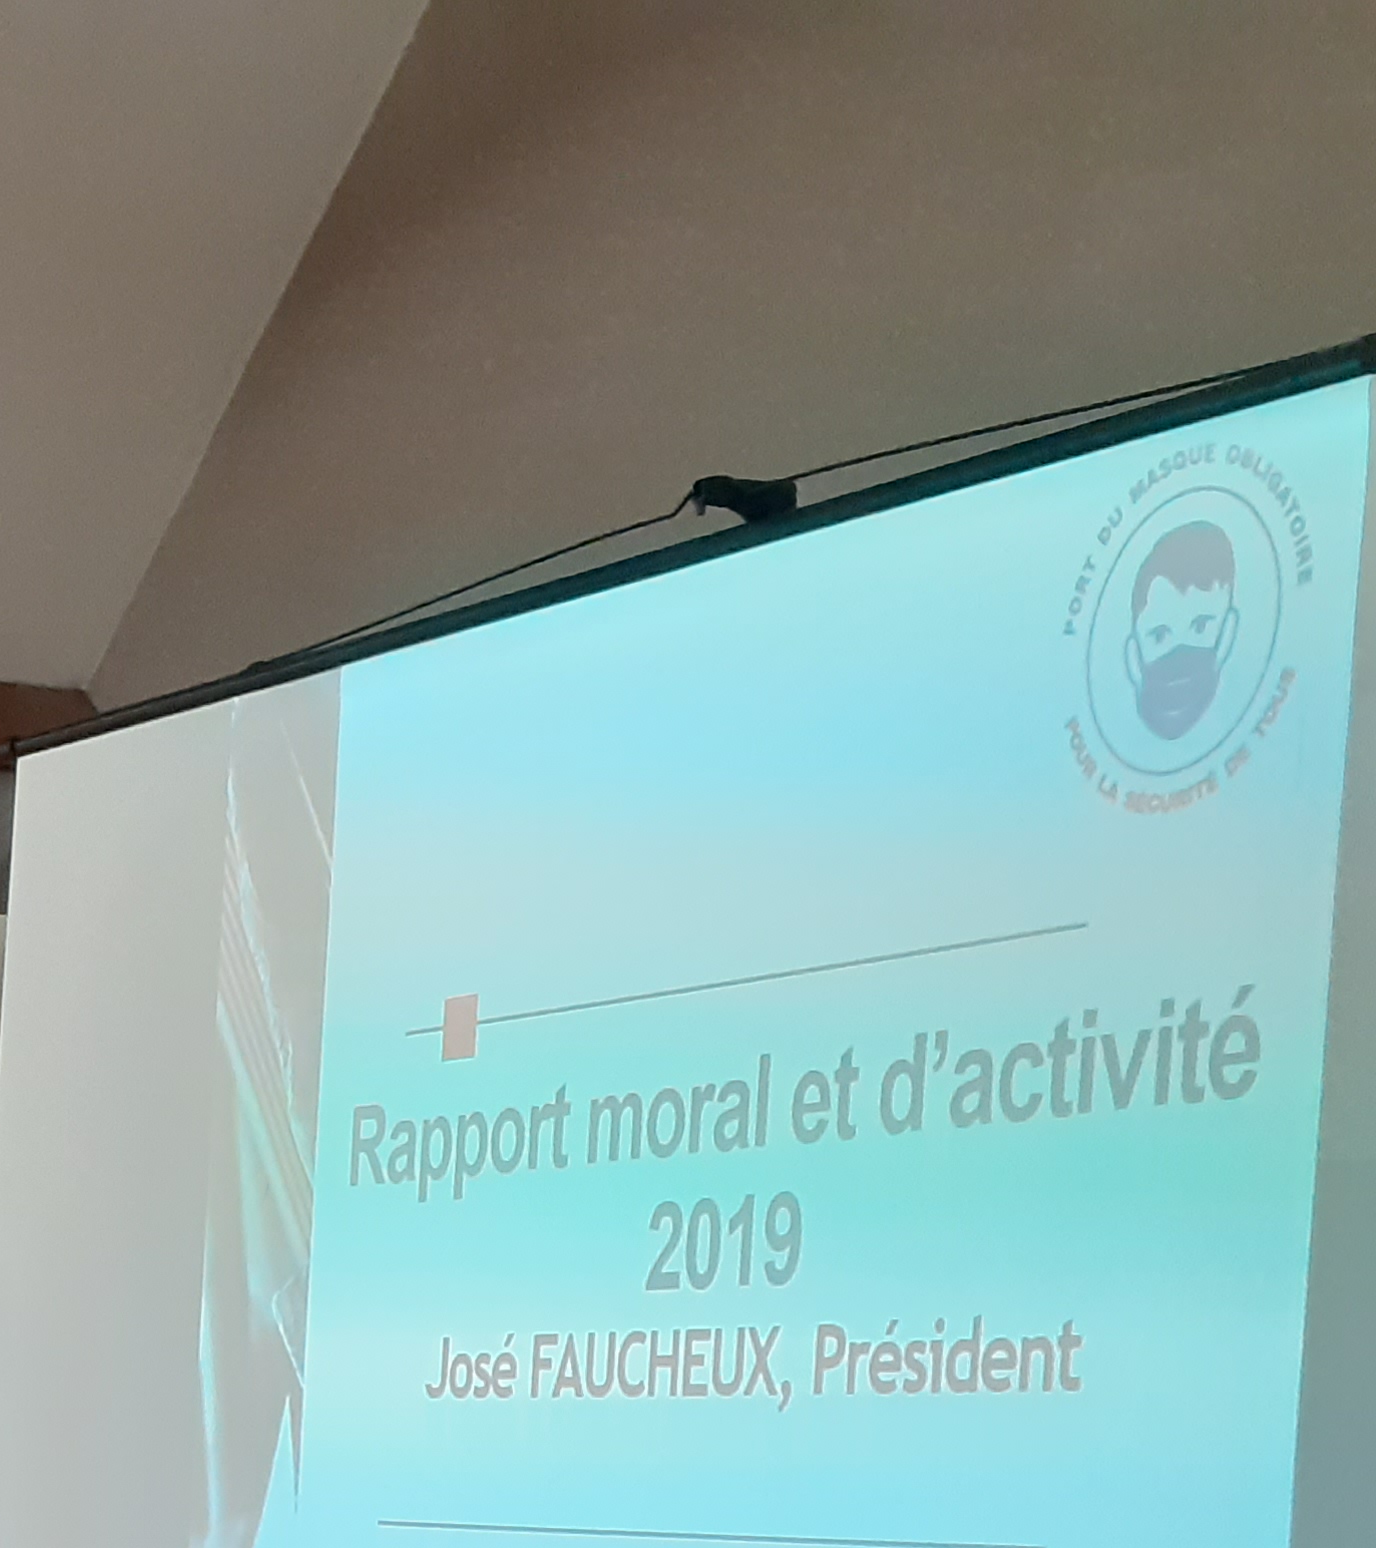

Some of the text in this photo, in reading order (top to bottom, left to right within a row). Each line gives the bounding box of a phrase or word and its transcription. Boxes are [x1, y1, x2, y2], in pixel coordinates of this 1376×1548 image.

[1062, 443, 1314, 637] PORT DU MASQUE OBLIGATOIRE
[1098, 774, 1118, 804] LA
[350, 983, 1261, 1202] Rapport moral et d'activité
[645, 1191, 803, 1292] 2019
[424, 1314, 1084, 1413] José FAUCHEUX, Président
